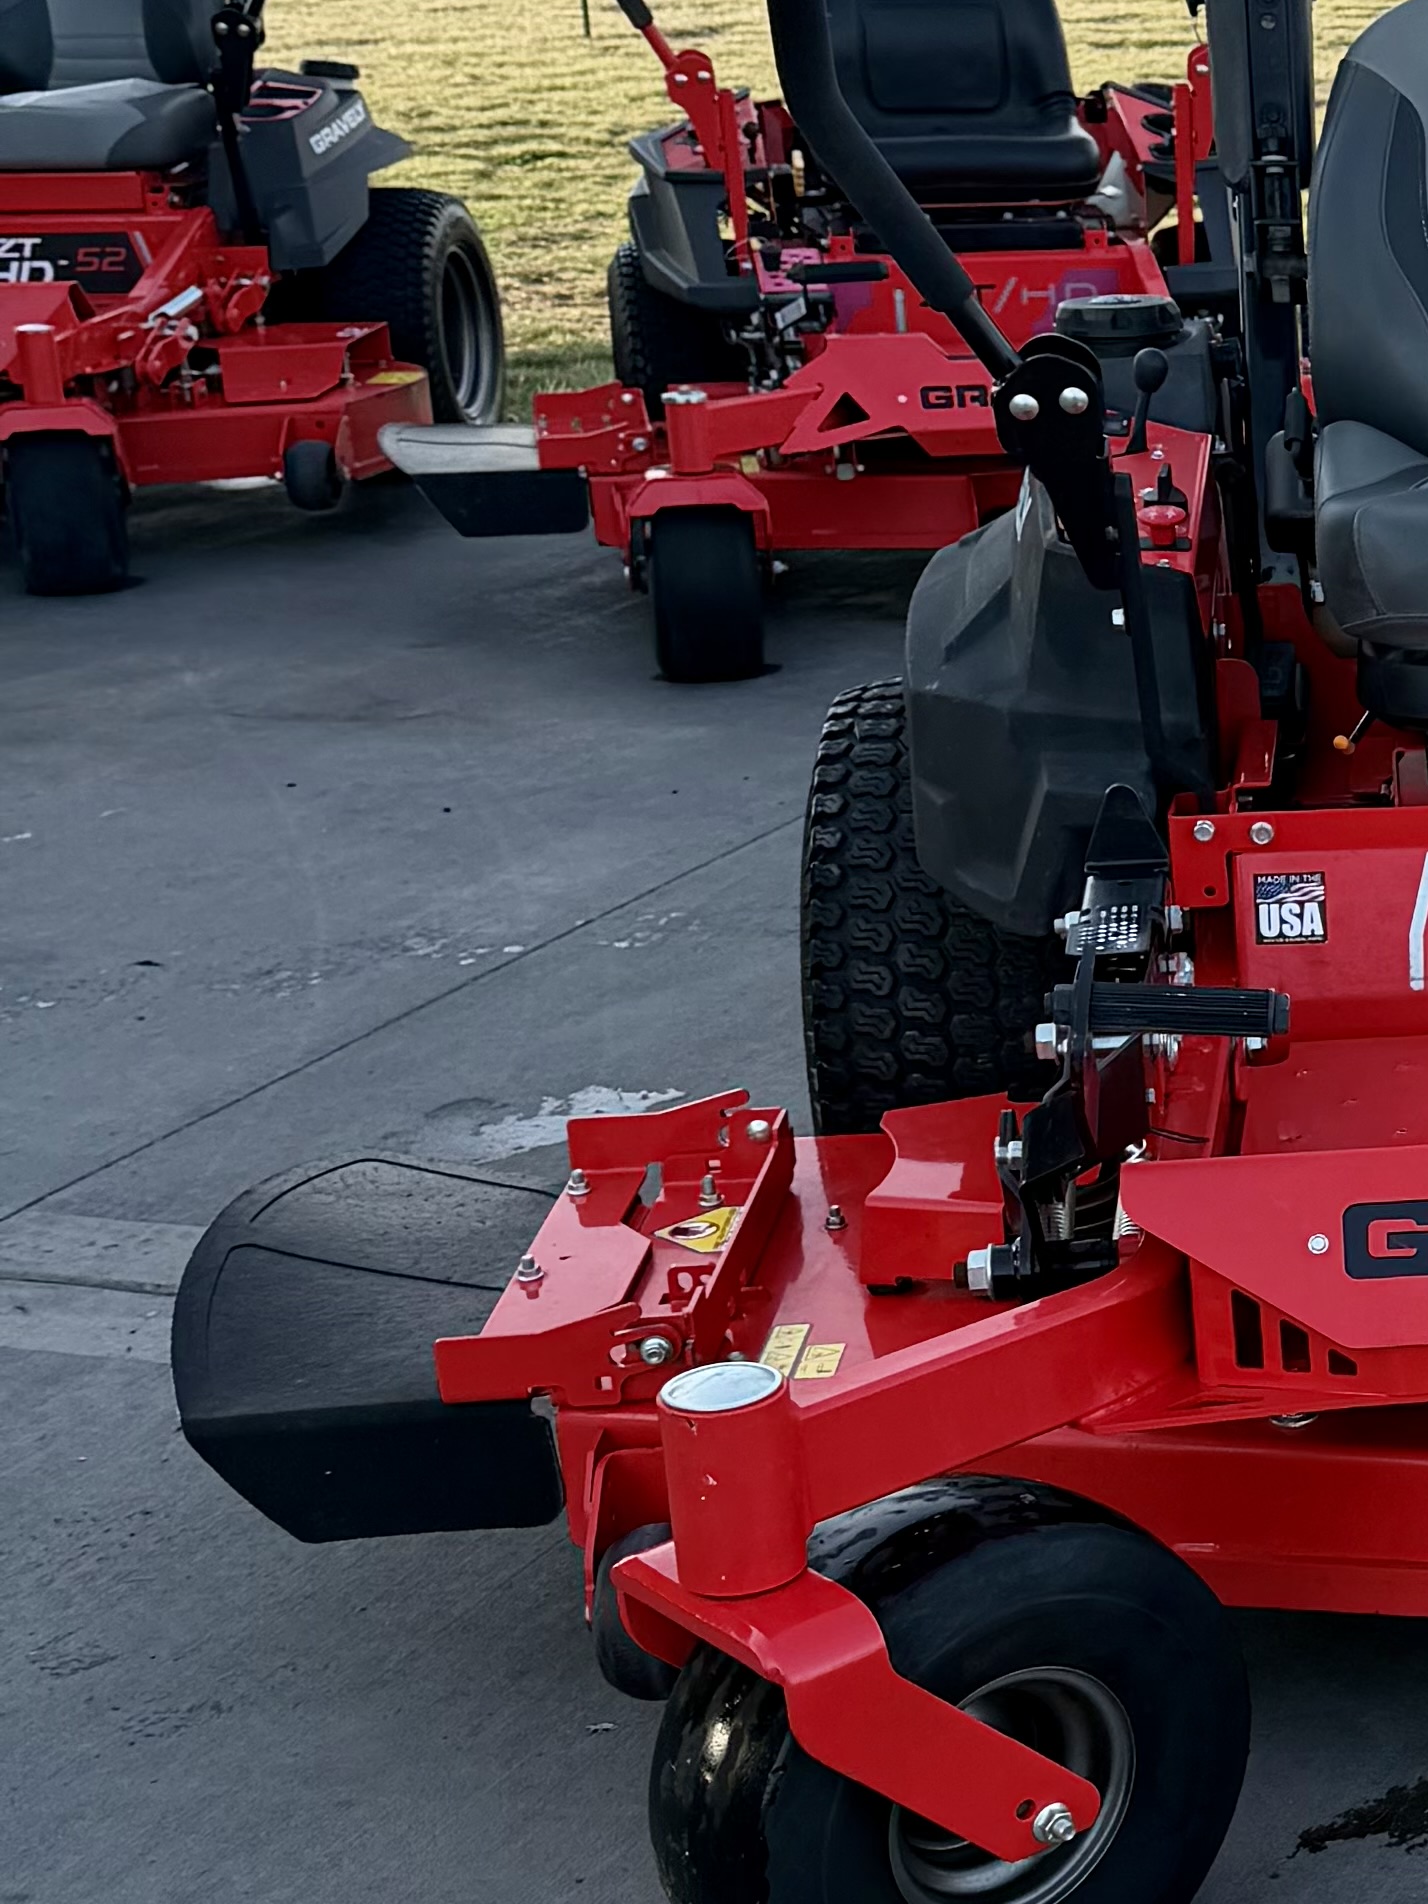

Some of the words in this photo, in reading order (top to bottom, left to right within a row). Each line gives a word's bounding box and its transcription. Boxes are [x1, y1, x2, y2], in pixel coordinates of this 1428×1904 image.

[310, 99, 366, 155] GRAVELY
[1257, 875, 1287, 884] MADE
[1289, 875, 1300, 883] IN
[1303, 873, 1322, 882] THE
[1259, 902, 1324, 938] USA
